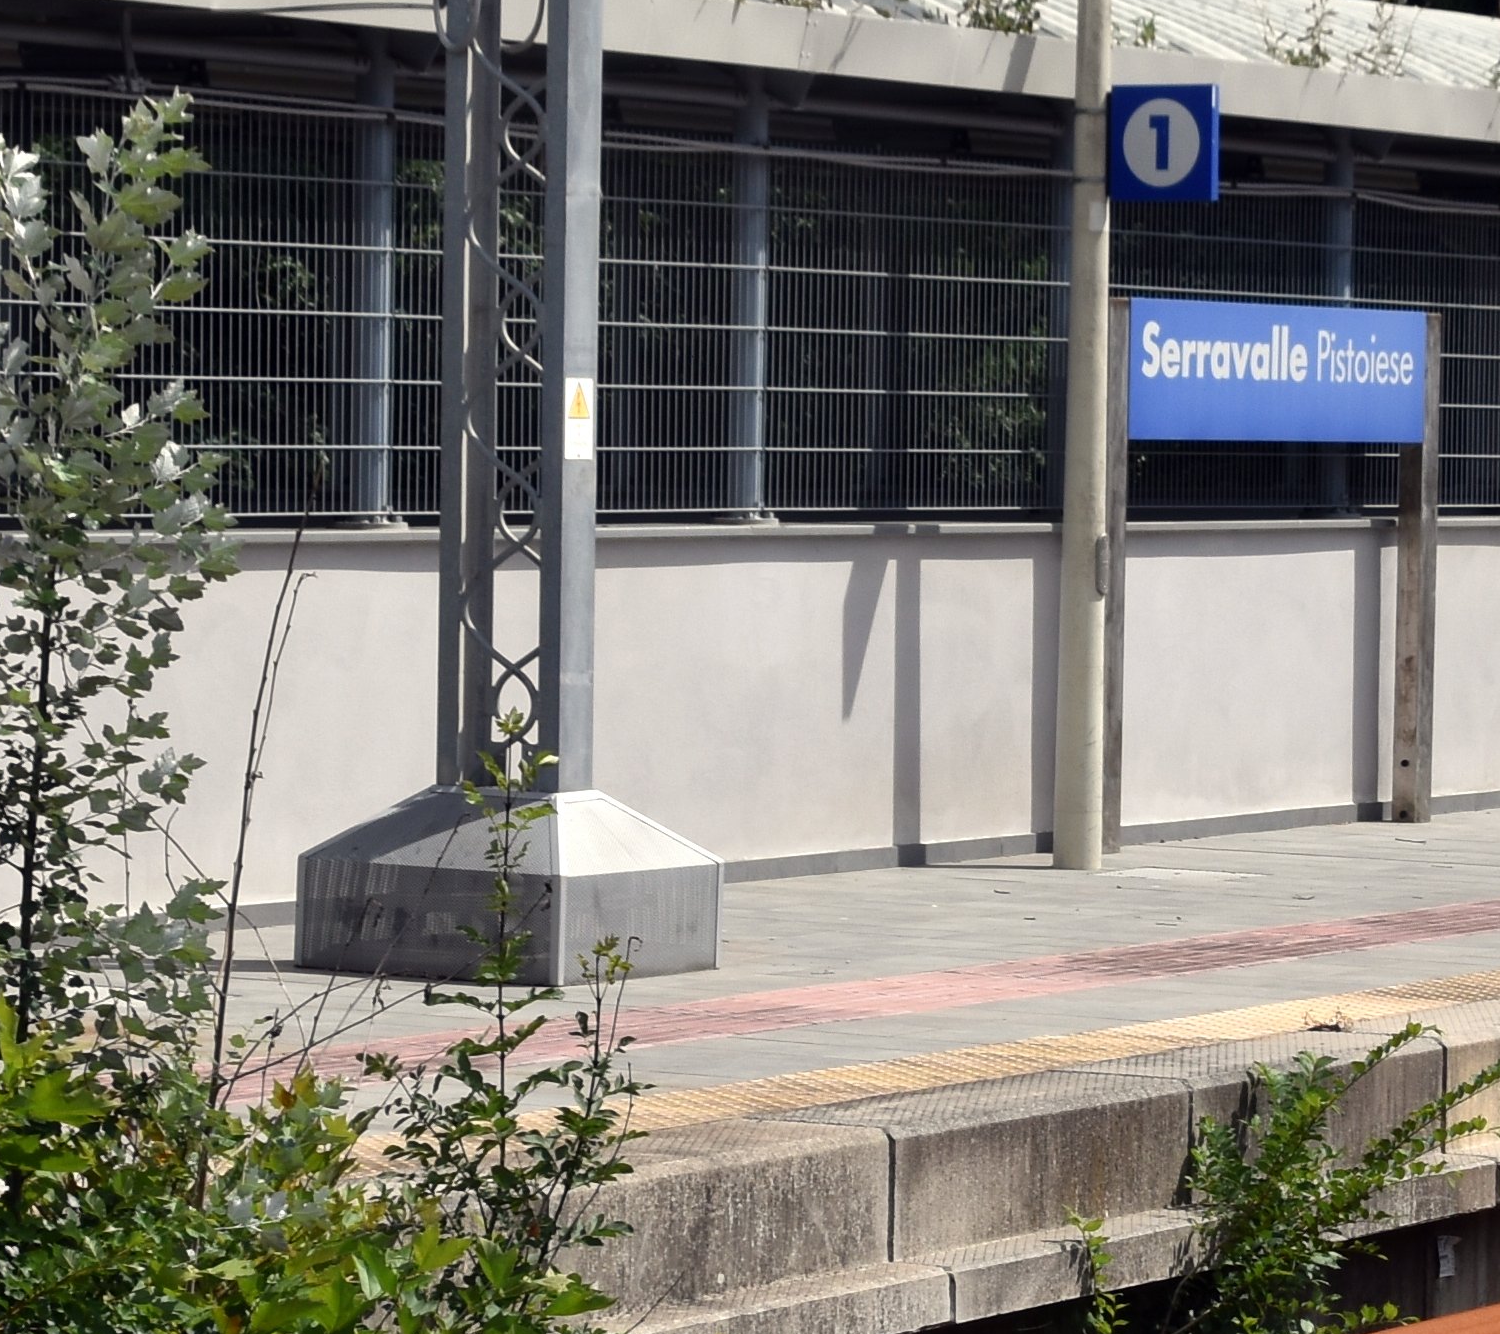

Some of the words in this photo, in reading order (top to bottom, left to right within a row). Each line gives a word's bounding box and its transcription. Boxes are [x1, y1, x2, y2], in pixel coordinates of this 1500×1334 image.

[1149, 114, 1170, 170] 1
[1141, 321, 1309, 382] Serravalle
[1316, 329, 1414, 386] Pistoiese
